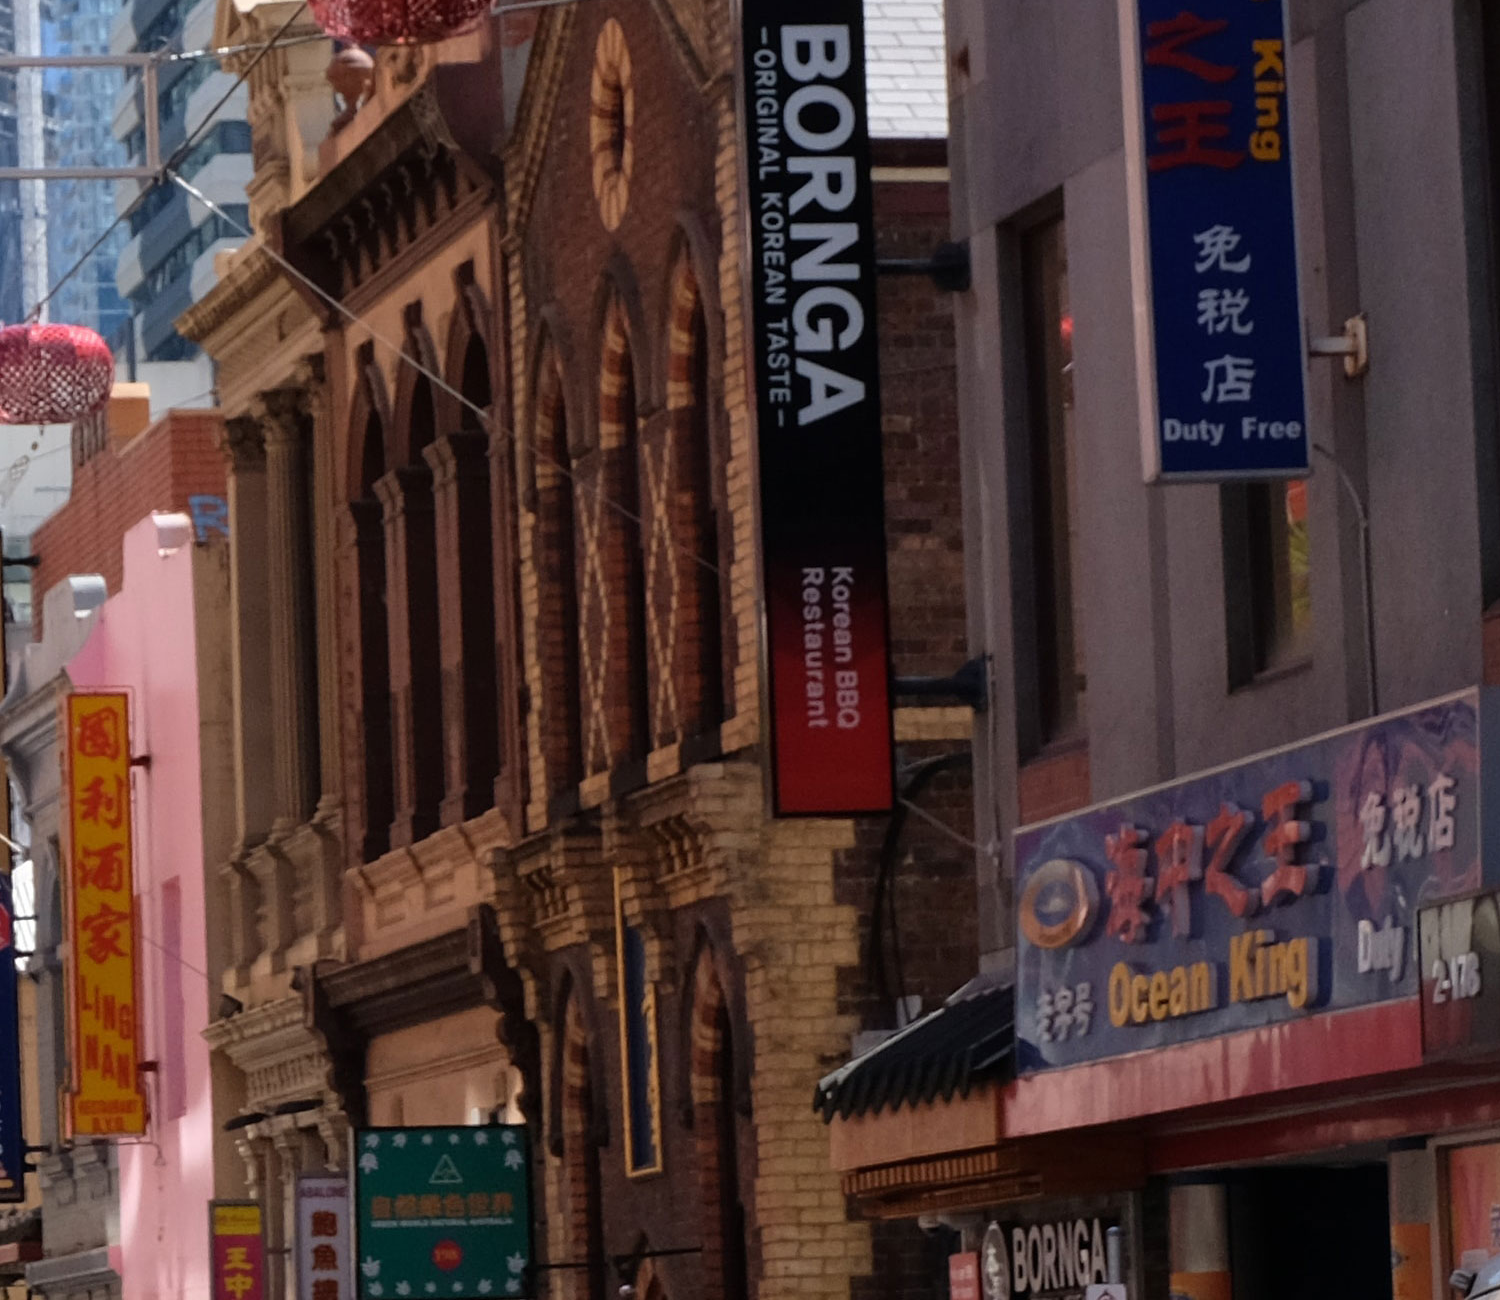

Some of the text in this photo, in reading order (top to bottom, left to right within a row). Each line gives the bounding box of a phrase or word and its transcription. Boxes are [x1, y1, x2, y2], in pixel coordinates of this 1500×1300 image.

[1249, 38, 1283, 163] King
[761, 190, 787, 306] KOREAN
[781, 22, 866, 428] BORNGA
[1192, 222, 1257, 404] 免税店
[1163, 417, 1302, 446] Duty Free
[800, 564, 829, 727] Restaurant
[830, 564, 862, 730] Korean BBQ
[1104, 779, 1327, 945] 海中之王
[1357, 774, 1458, 869] 免税店
[79, 974, 132, 1041] LING
[1107, 928, 1320, 1028] Ocean King
[85, 1034, 131, 1090] NAN
[1012, 1217, 1108, 1294] BORNGA
